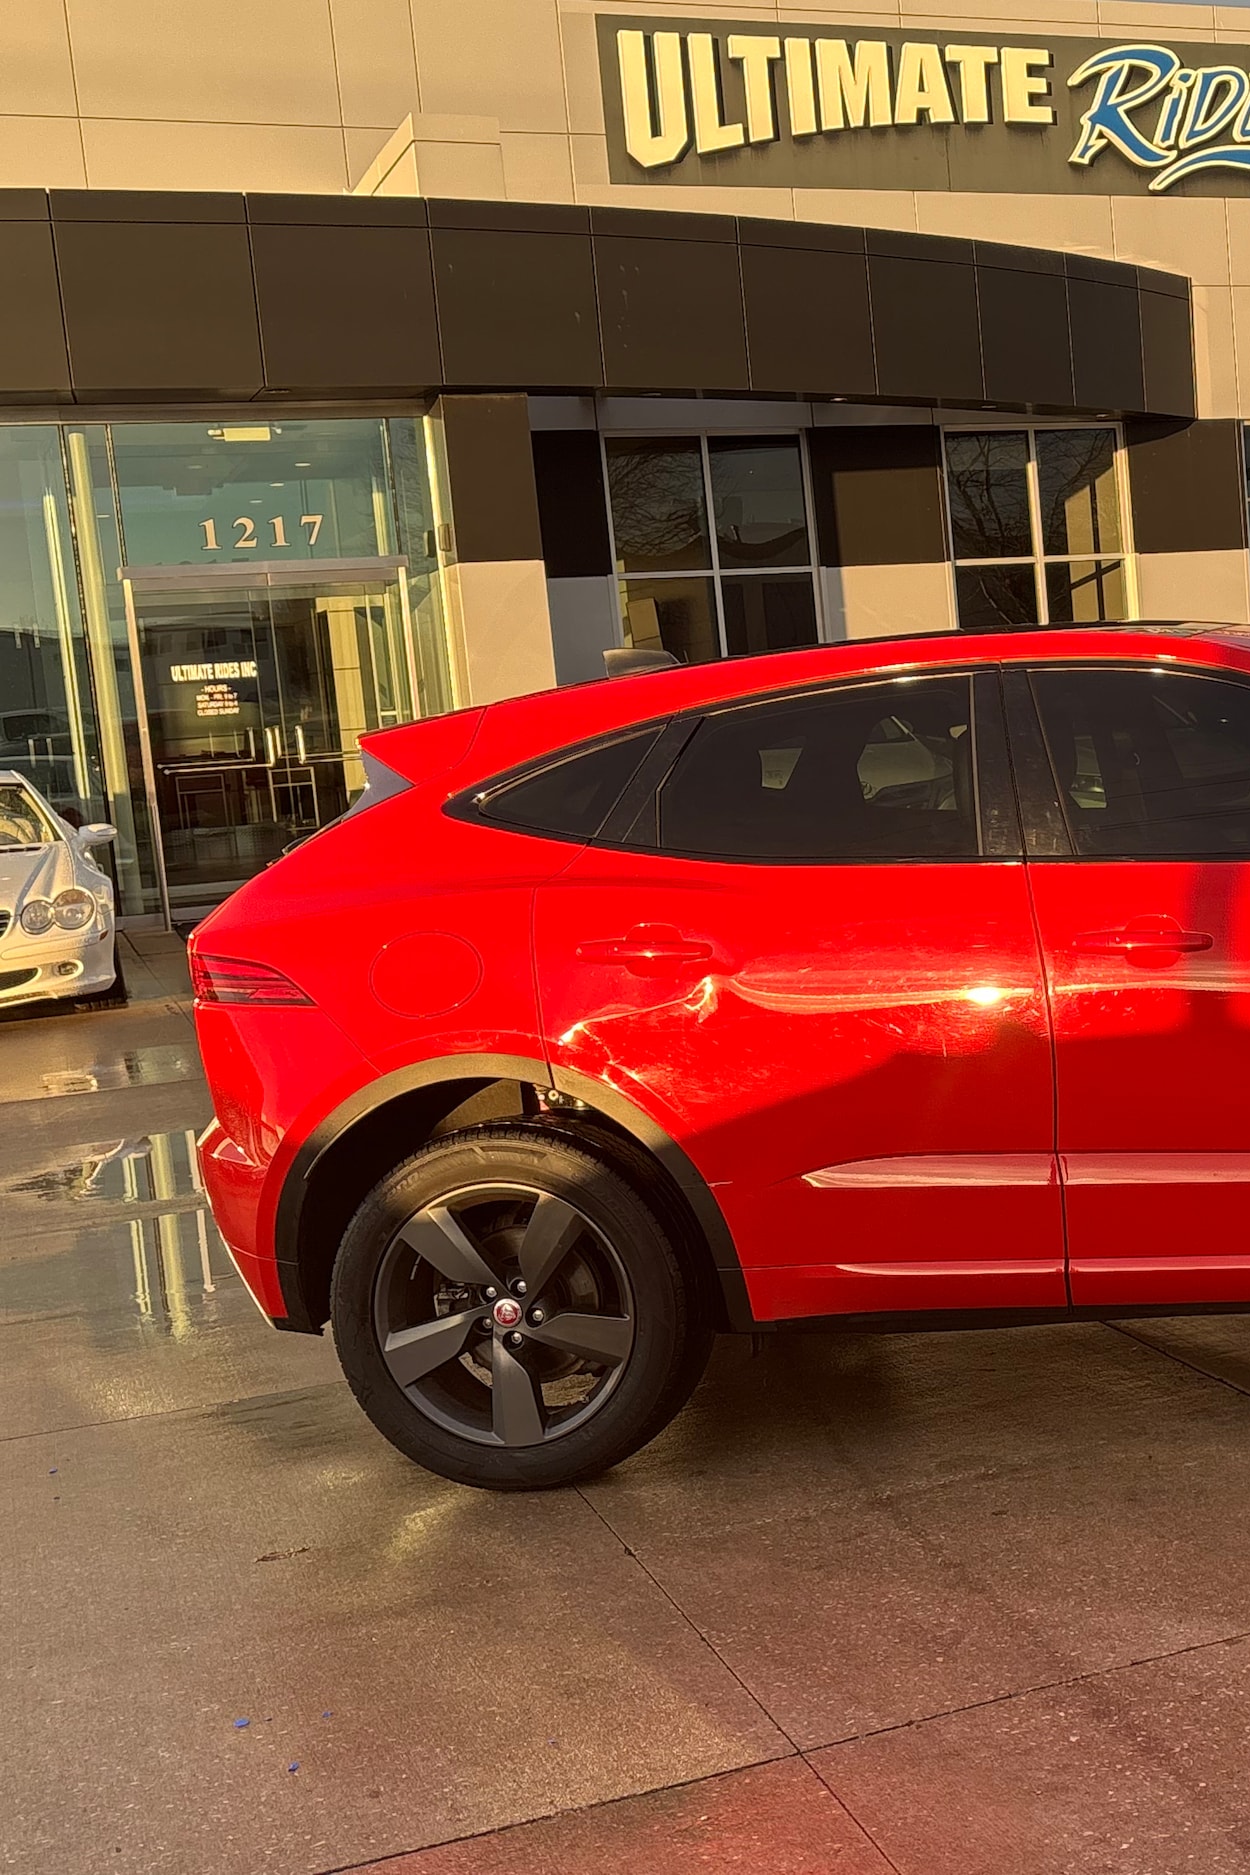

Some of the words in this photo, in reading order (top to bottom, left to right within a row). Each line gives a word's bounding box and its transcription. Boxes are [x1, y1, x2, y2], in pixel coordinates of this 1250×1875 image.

[617, 29, 1054, 167] ULTIMATE
[199, 514, 323, 549] 1217
[170, 663, 214, 682] ULTIMATE
[214, 662, 240, 679] RIDES
[240, 661, 258, 678] INC
[204, 684, 228, 693] HOURS
